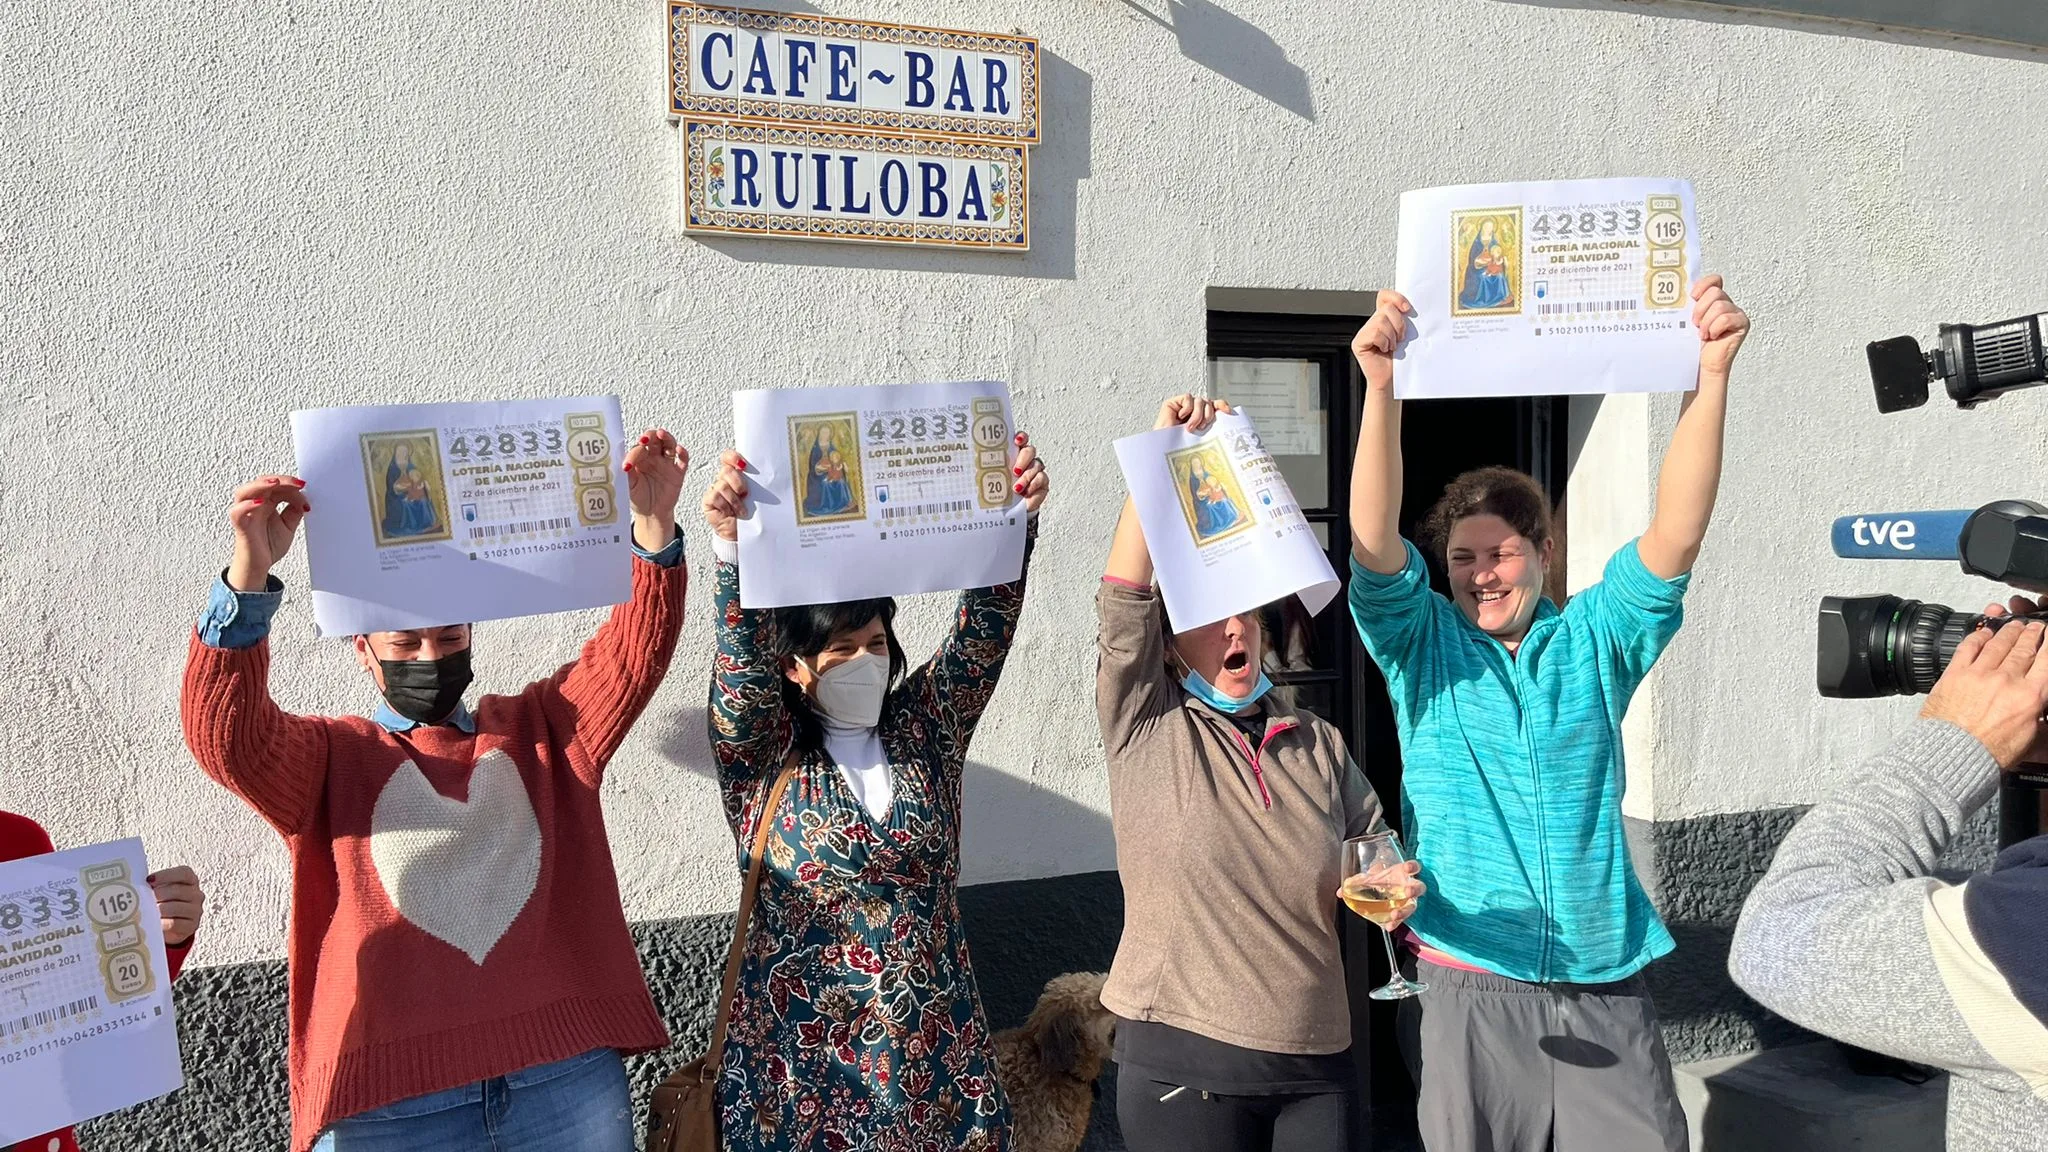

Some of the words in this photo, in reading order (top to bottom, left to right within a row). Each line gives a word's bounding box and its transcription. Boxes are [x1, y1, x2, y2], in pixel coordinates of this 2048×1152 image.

[731, 148, 988, 222] RUILOBA
[1532, 209, 1641, 235] 42833
[1582, 240, 1640, 251] NACIONAL
[1550, 256, 1564, 264] DE
[1568, 252, 1620, 262] NAVIDAD
[1549, 266, 1558, 274] de
[1562, 265, 1599, 274] diciembre
[1602, 264, 1611, 272] de
[1614, 263, 1632, 271] 2021
[1658, 282, 1674, 294] 20
[868, 413, 968, 439] 42833
[450, 428, 562, 457] 42833
[916, 443, 968, 454] NACIONAL
[506, 459, 564, 471] NACIONAL
[888, 460, 902, 468] DE
[906, 456, 951, 466] NAVIDAD
[494, 472, 546, 483] NAVIDAD
[899, 469, 934, 477] diciembre
[488, 486, 526, 496] diciembre
[542, 482, 560, 490] 2021
[988, 482, 1002, 494] 20
[589, 498, 604, 510] 20
[1851, 517, 1915, 550] tve
[12, 925, 84, 951] NACIONAL
[0, 945, 62, 969] NAVIDAD
[44, 962, 55, 972] de
[59, 954, 81, 967] 2021
[119, 964, 138, 981] 20
